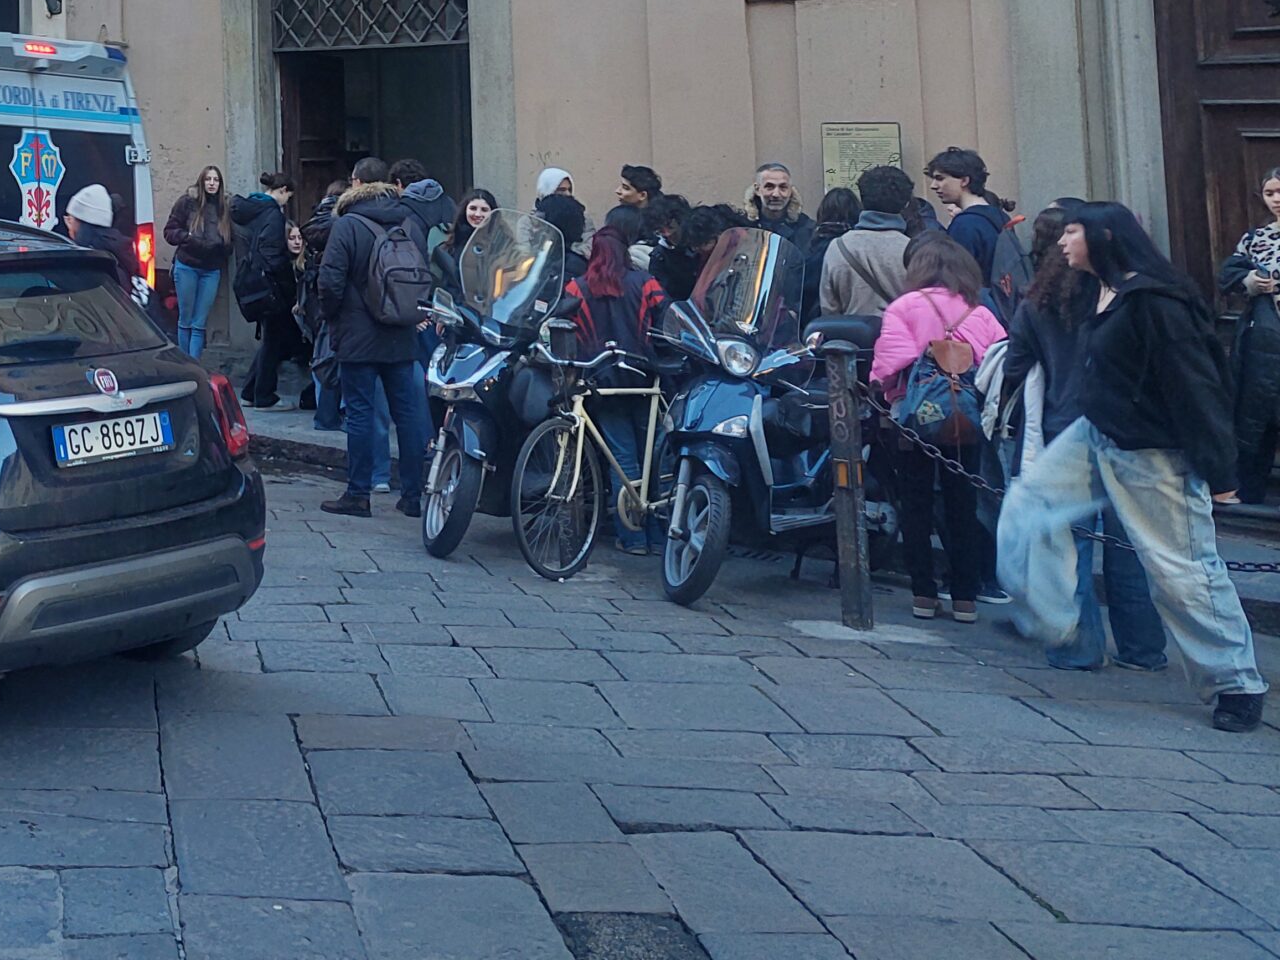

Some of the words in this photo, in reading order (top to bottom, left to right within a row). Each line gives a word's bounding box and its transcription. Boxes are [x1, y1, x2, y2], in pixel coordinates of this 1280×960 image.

[50, 94, 59, 108] di
[63, 90, 118, 113] FIRENZE
[68, 427, 93, 455] GC
[100, 416, 160, 450] 869ZJ
